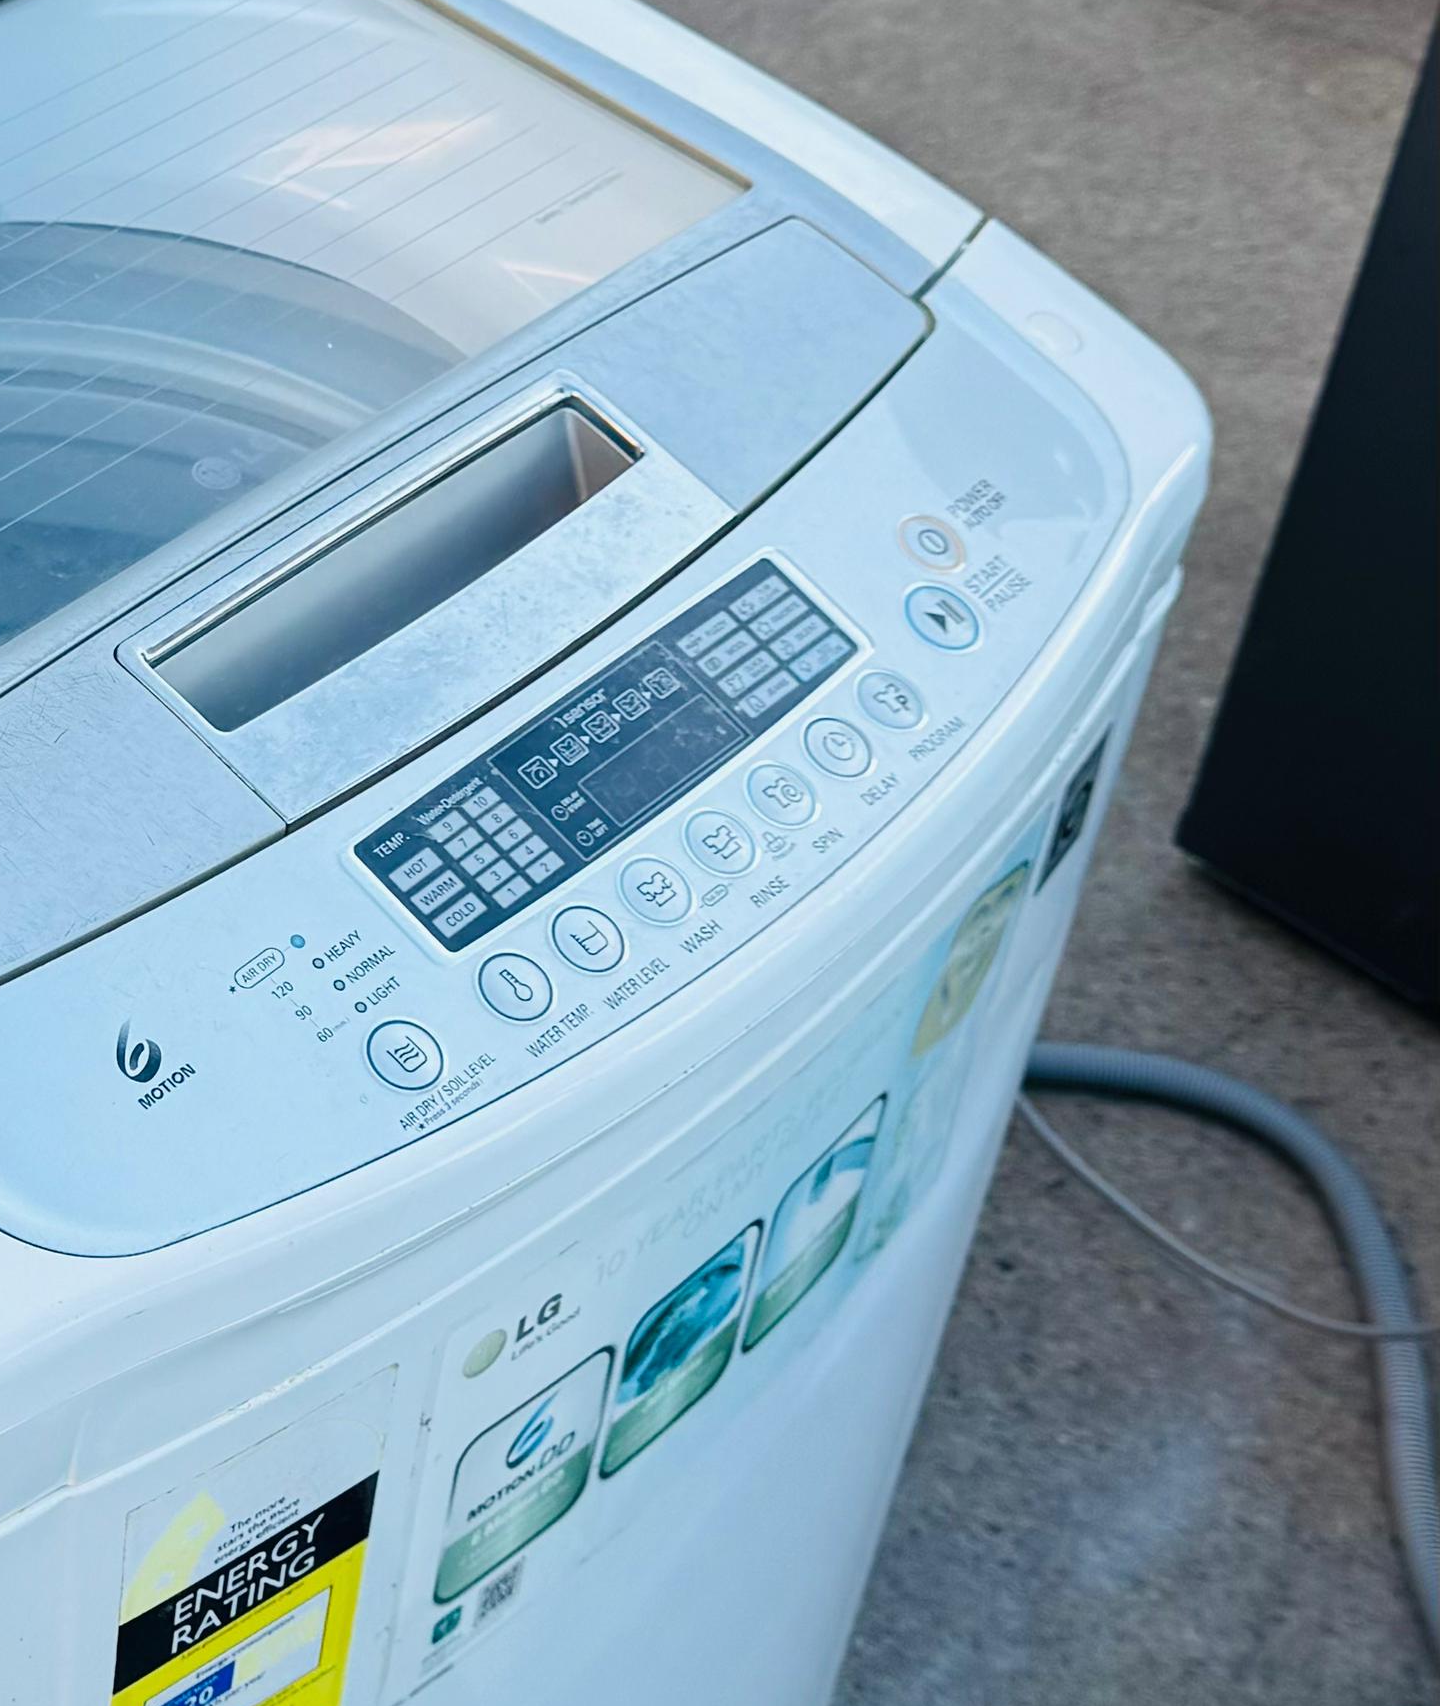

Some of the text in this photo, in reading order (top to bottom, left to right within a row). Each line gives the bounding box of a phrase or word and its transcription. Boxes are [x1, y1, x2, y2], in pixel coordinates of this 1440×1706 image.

[946, 479, 994, 518] POWER
[964, 555, 1009, 595] START
[984, 572, 1033, 613] PAUSE
[908, 716, 967, 761] PROGRAM
[860, 772, 901, 806] DELAY
[442, 796, 489, 832] 9 10
[457, 813, 503, 849] 7 8
[373, 832, 411, 858] TEMP.
[475, 829, 520, 865] 5 6
[811, 826, 845, 854] SPIN
[403, 858, 430, 881] HOT
[491, 846, 535, 881] 3 4
[507, 862, 551, 896] 1 2
[419, 876, 459, 907] WARM
[749, 874, 791, 909] RINSE
[446, 901, 477, 928] COLD
[323, 929, 363, 963] HEAVY
[679, 919, 724, 954] WASH
[241, 952, 278, 984] AIR DRY
[345, 945, 396, 984] NORMAL
[271, 981, 294, 1000] 120
[366, 976, 401, 1006] LIGHT
[602, 957, 671, 1011] WATER LEVEL
[295, 1005, 313, 1021] 90
[525, 1003, 594, 1059] WATER TEMP.
[316, 1027, 334, 1043] 60
[137, 1063, 198, 1110] MOTION
[399, 1111, 420, 1131] AIR
[415, 1094, 440, 1117] DRY
[441, 1075, 469, 1096] SOIL
[463, 1053, 497, 1079] LEVEL
[514, 1293, 563, 1343] LG
[466, 1465, 537, 1522] MOTION
[218, 1499, 300, 1552] stars the more
[231, 1497, 286, 1533] The more
[173, 1513, 325, 1626] ENERGY
[214, 1538, 252, 1565] energy
[170, 1546, 316, 1654] RATING
